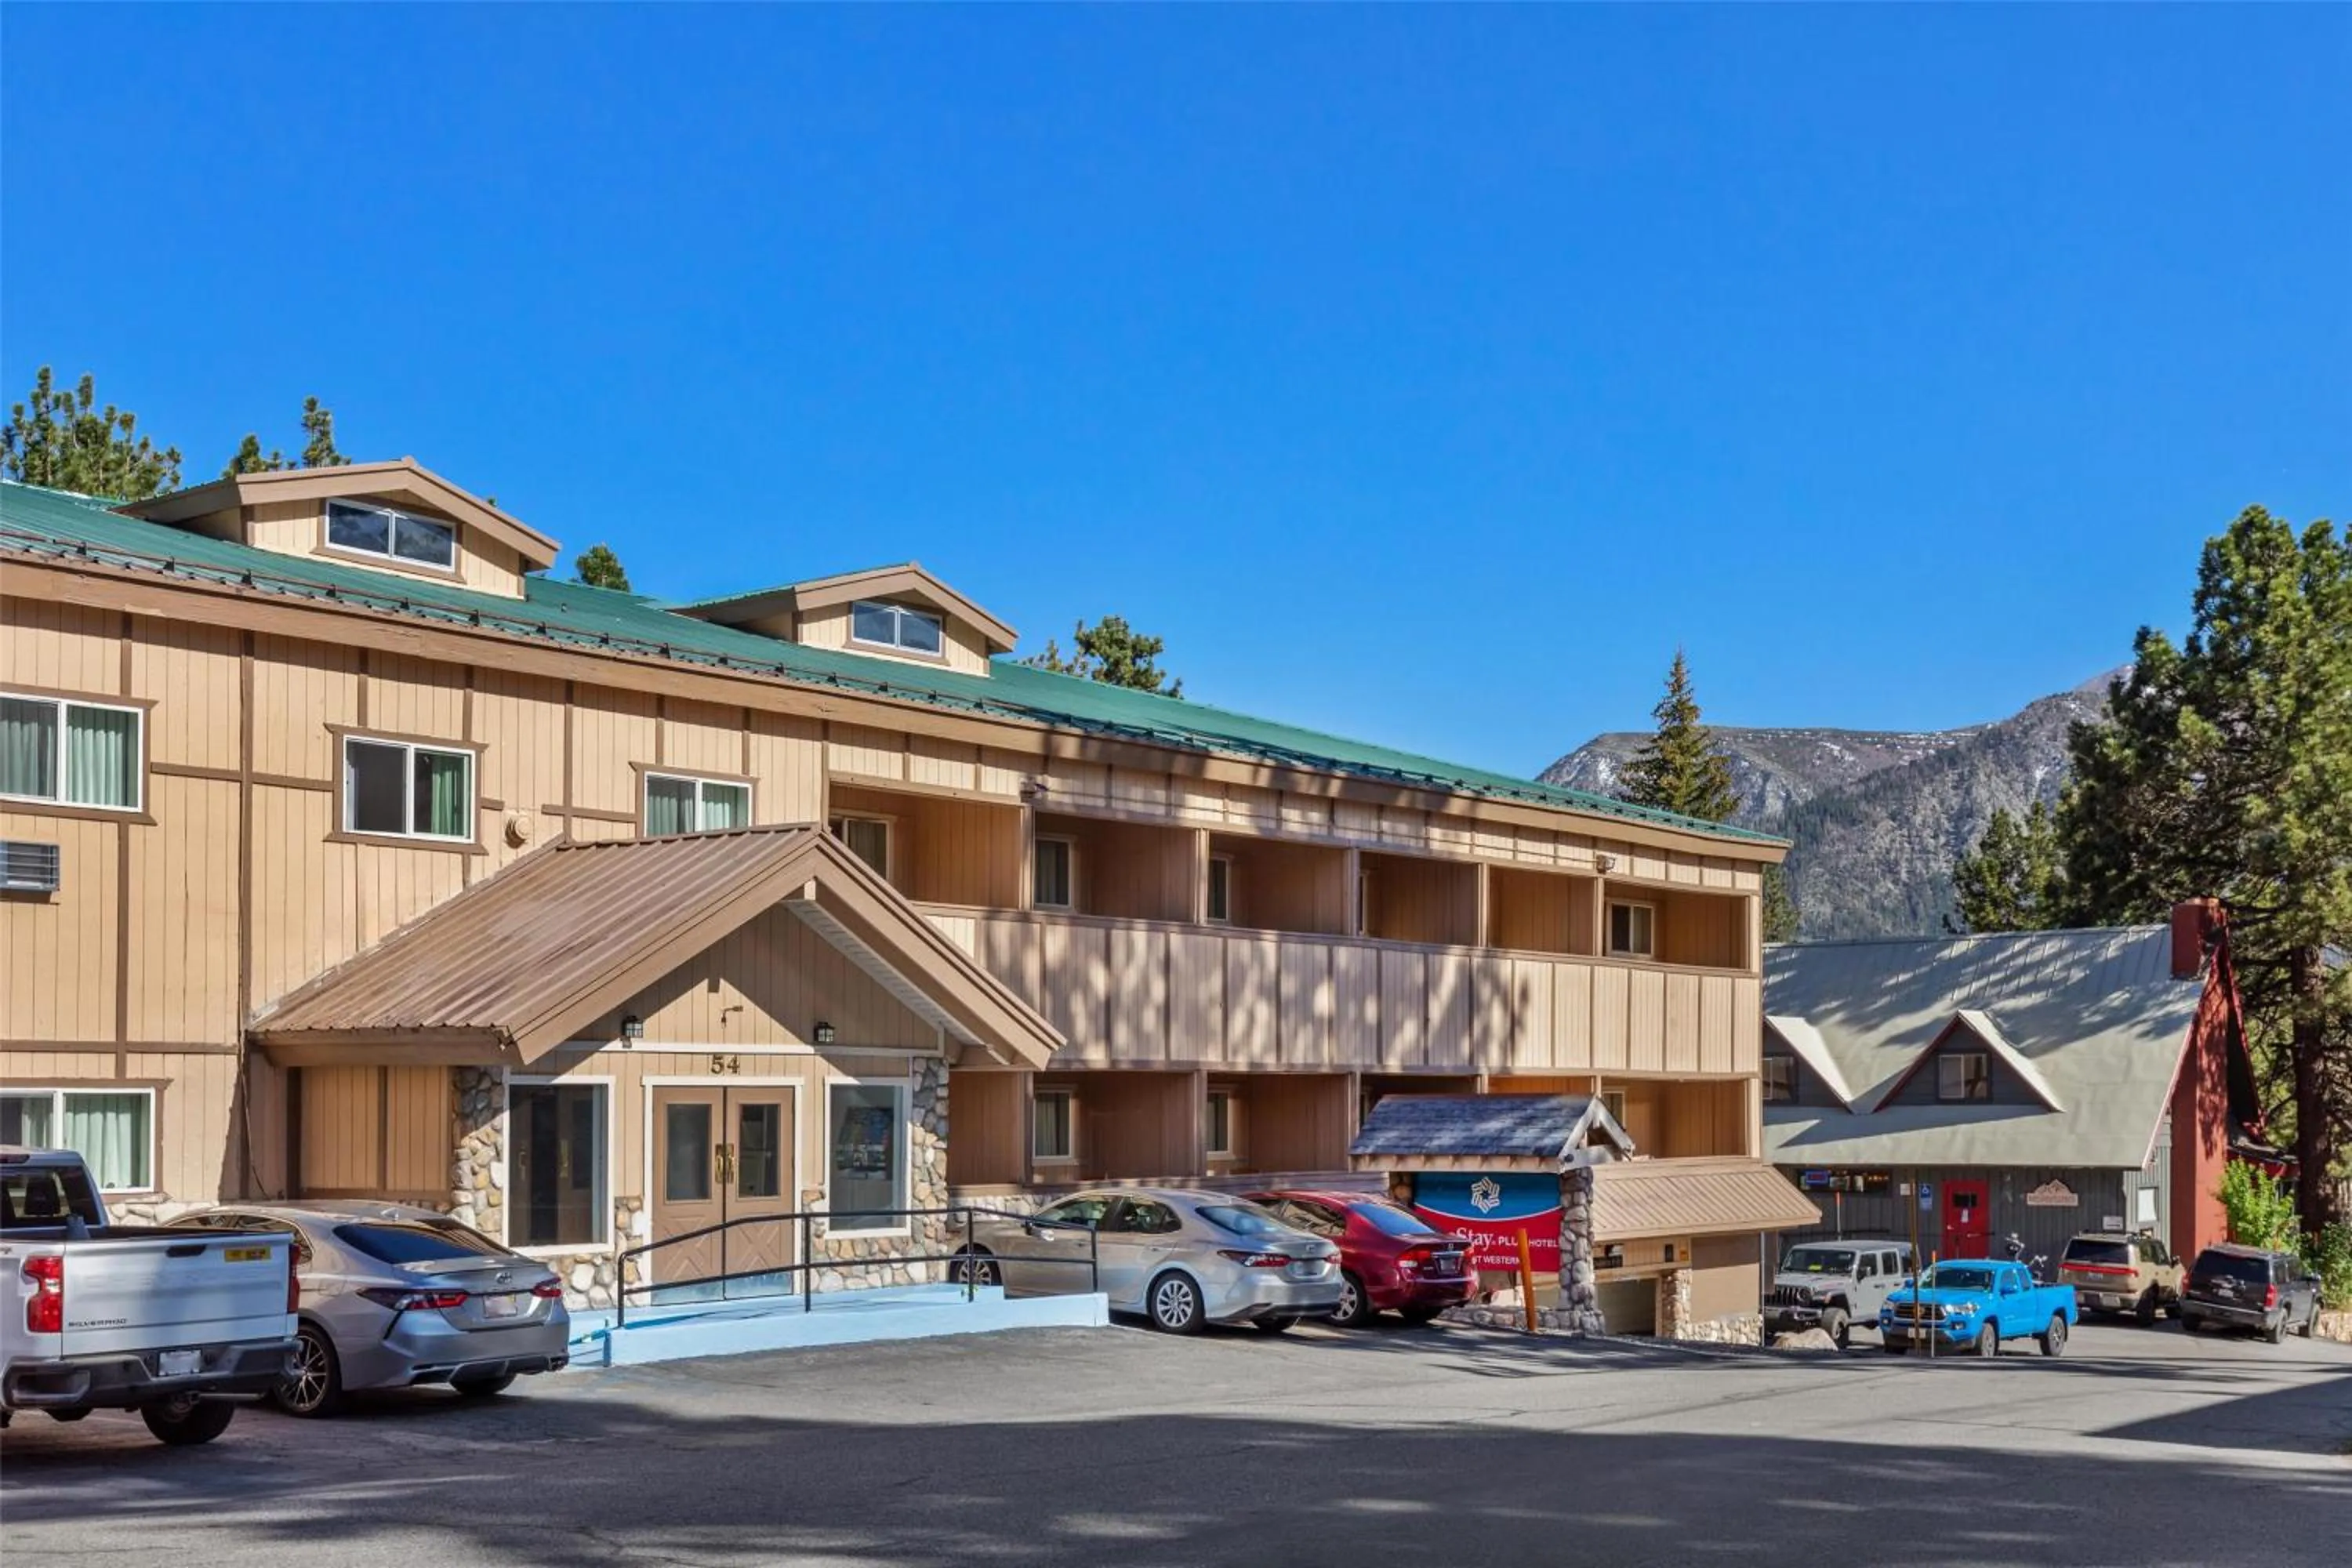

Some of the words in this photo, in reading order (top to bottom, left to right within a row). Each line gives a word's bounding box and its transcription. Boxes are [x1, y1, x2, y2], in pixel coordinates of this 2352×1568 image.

[711, 1055, 740, 1074] 54
[1454, 1227, 1494, 1251] Stay
[1529, 1239, 1559, 1248] HOTEL
